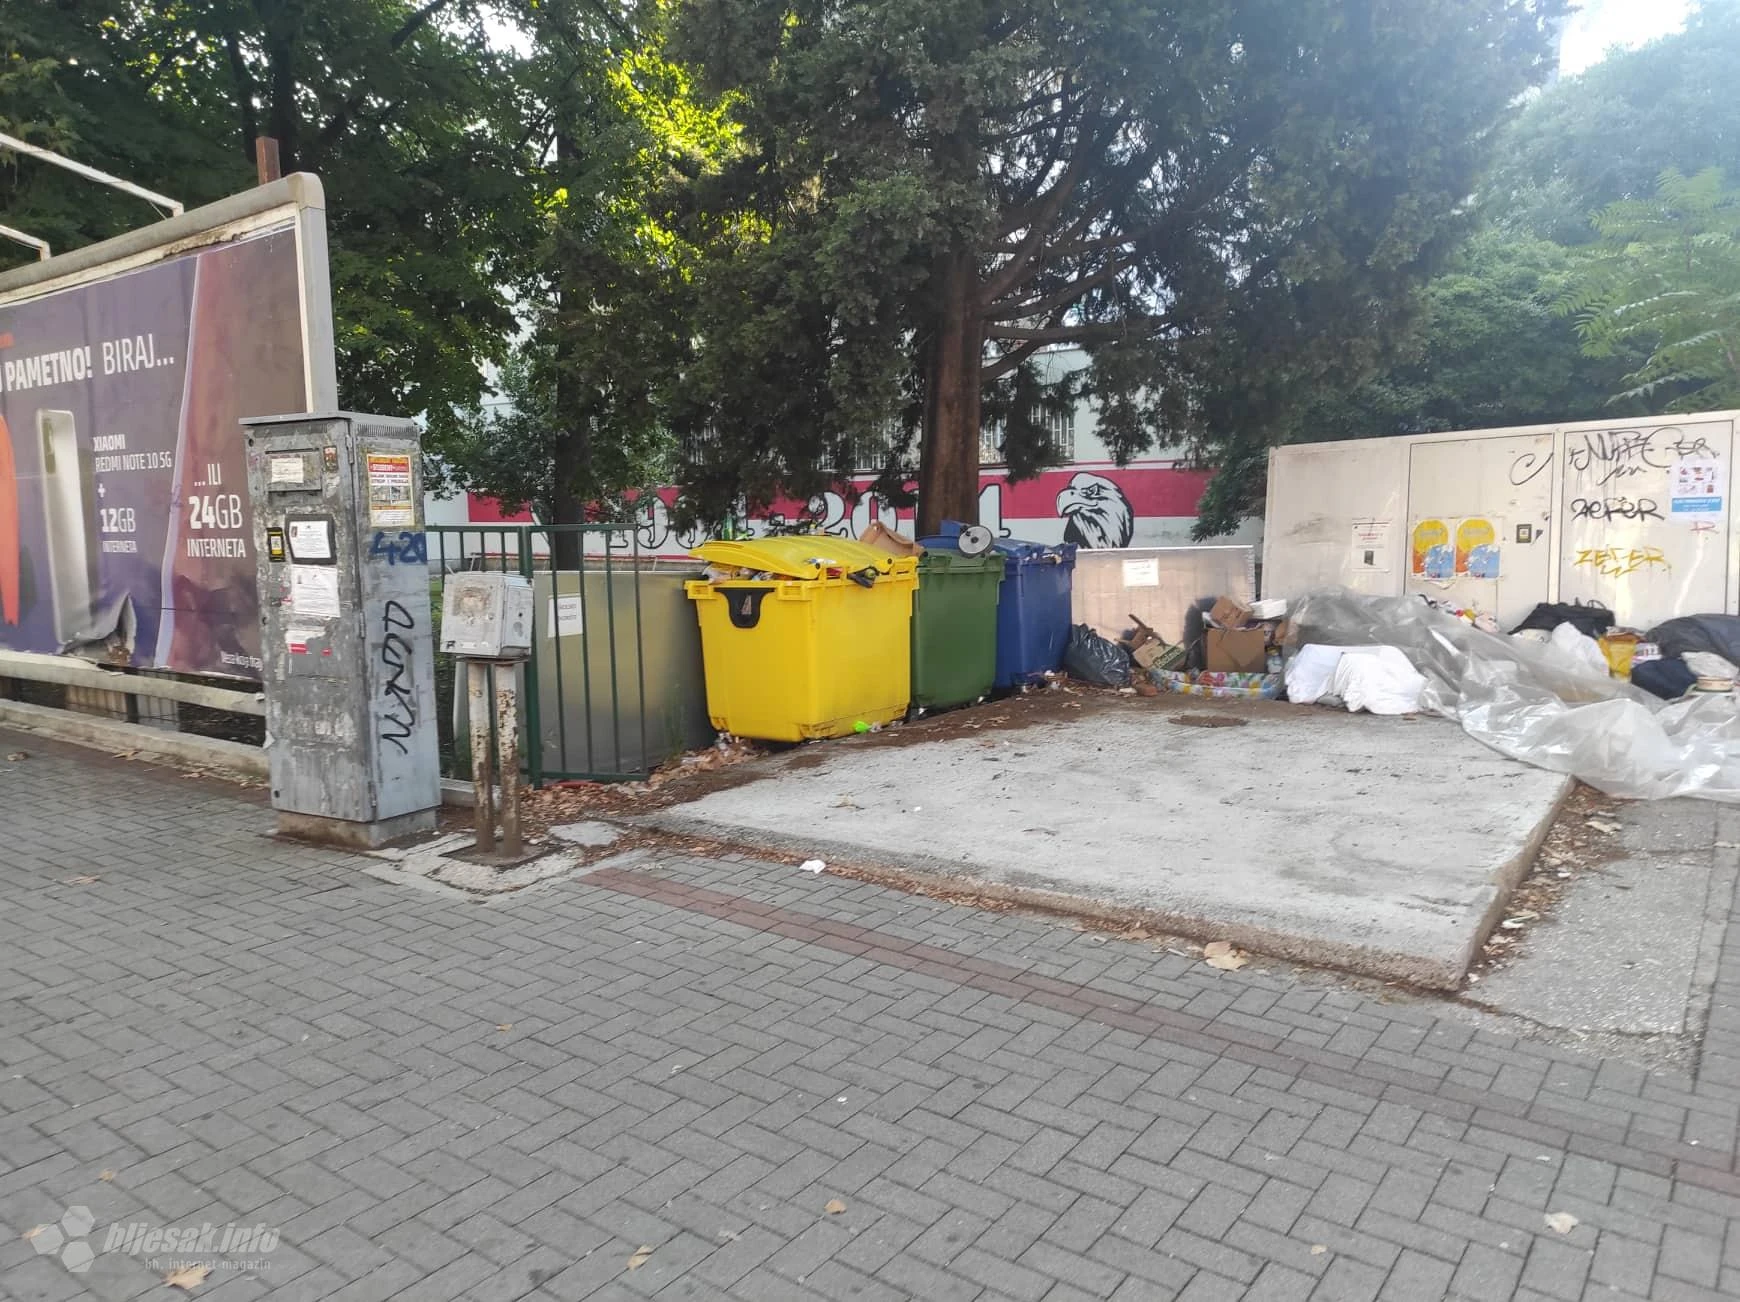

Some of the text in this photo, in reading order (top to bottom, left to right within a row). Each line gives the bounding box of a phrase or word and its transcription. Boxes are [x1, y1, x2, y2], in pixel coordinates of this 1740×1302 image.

[5, 346, 93, 391] PAMETNO!
[102, 333, 175, 375] BIRAJ...
[93, 434, 126, 452] XIAOMI
[95, 451, 173, 472] REDMI NOTE 10 5G
[100, 507, 137, 533] 12GB
[188, 494, 243, 530] 24GB
[102, 540, 137, 553] INTERNETA
[186, 537, 246, 558] INTERNETA
